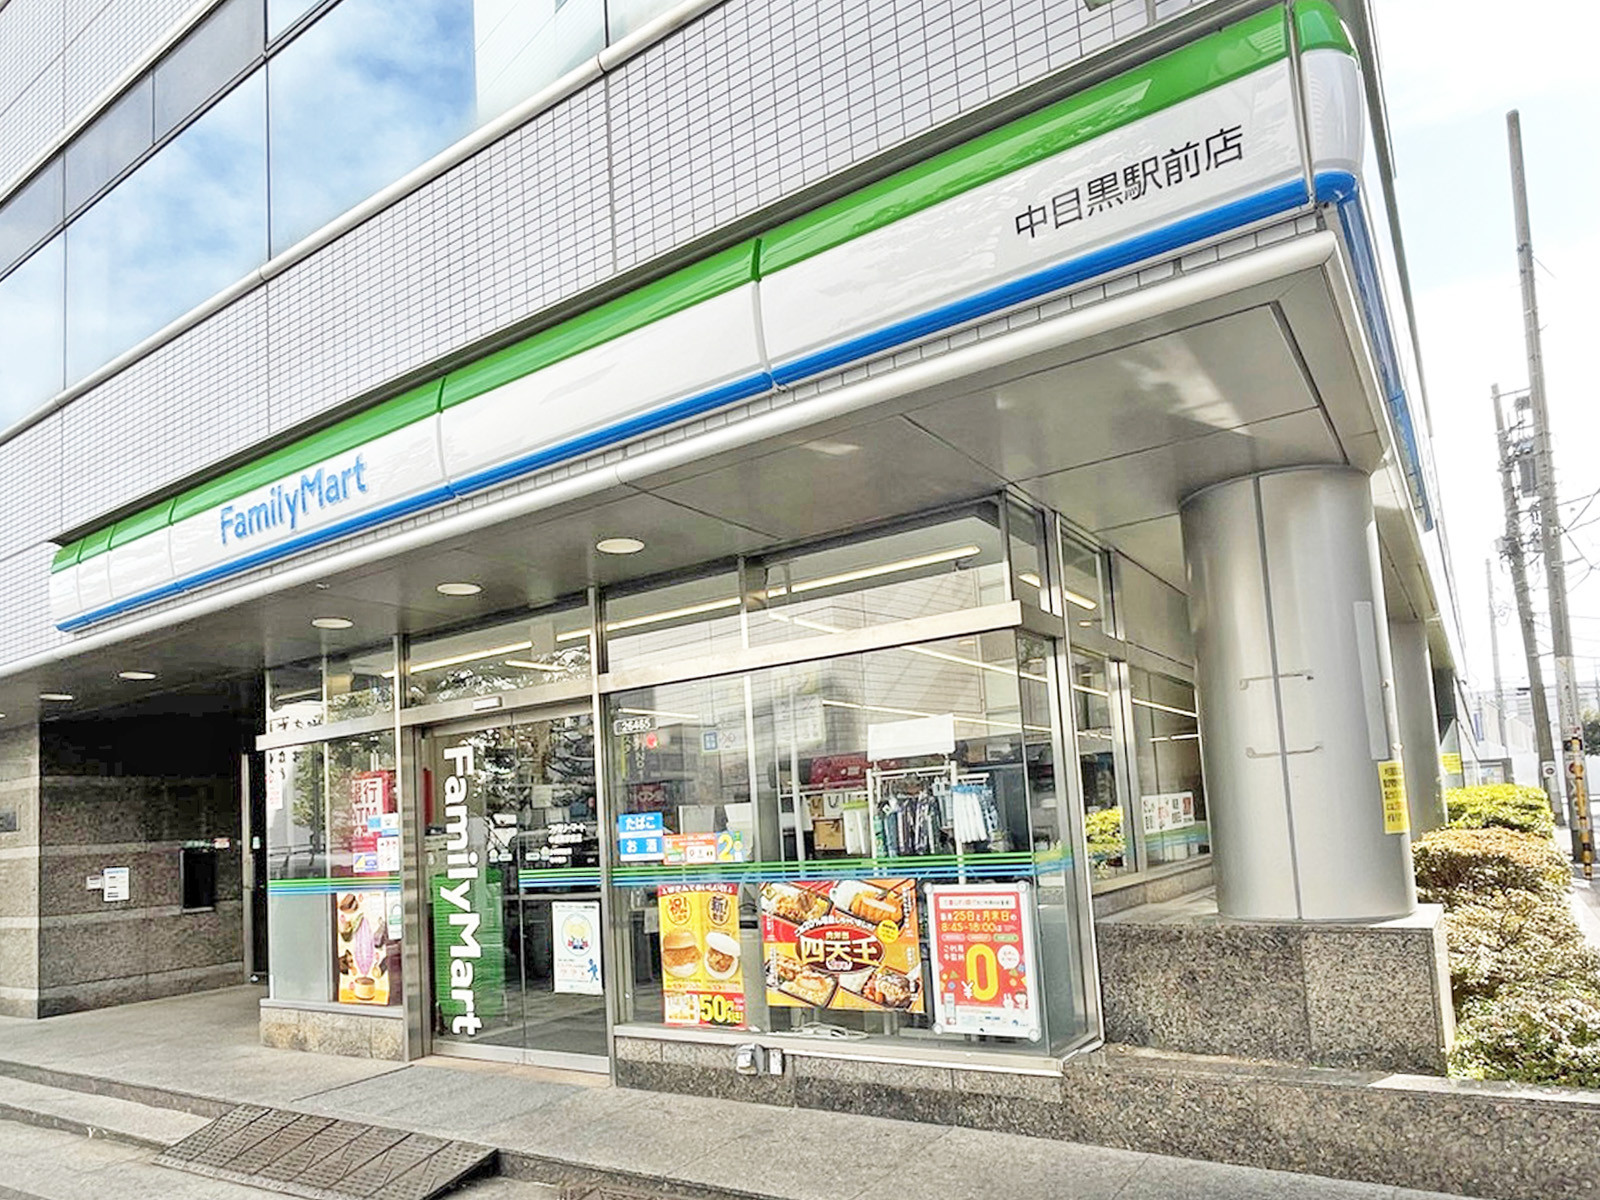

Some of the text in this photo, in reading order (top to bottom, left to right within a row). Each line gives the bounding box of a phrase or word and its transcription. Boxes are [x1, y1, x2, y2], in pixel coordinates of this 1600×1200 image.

[1015, 125, 1243, 238] 中目黒駅前店
[220, 454, 367, 545] FamilyMart
[625, 815, 657, 831] たばこ
[440, 746, 483, 1037] FamilyMart
[801, 935, 881, 966] 四天王
